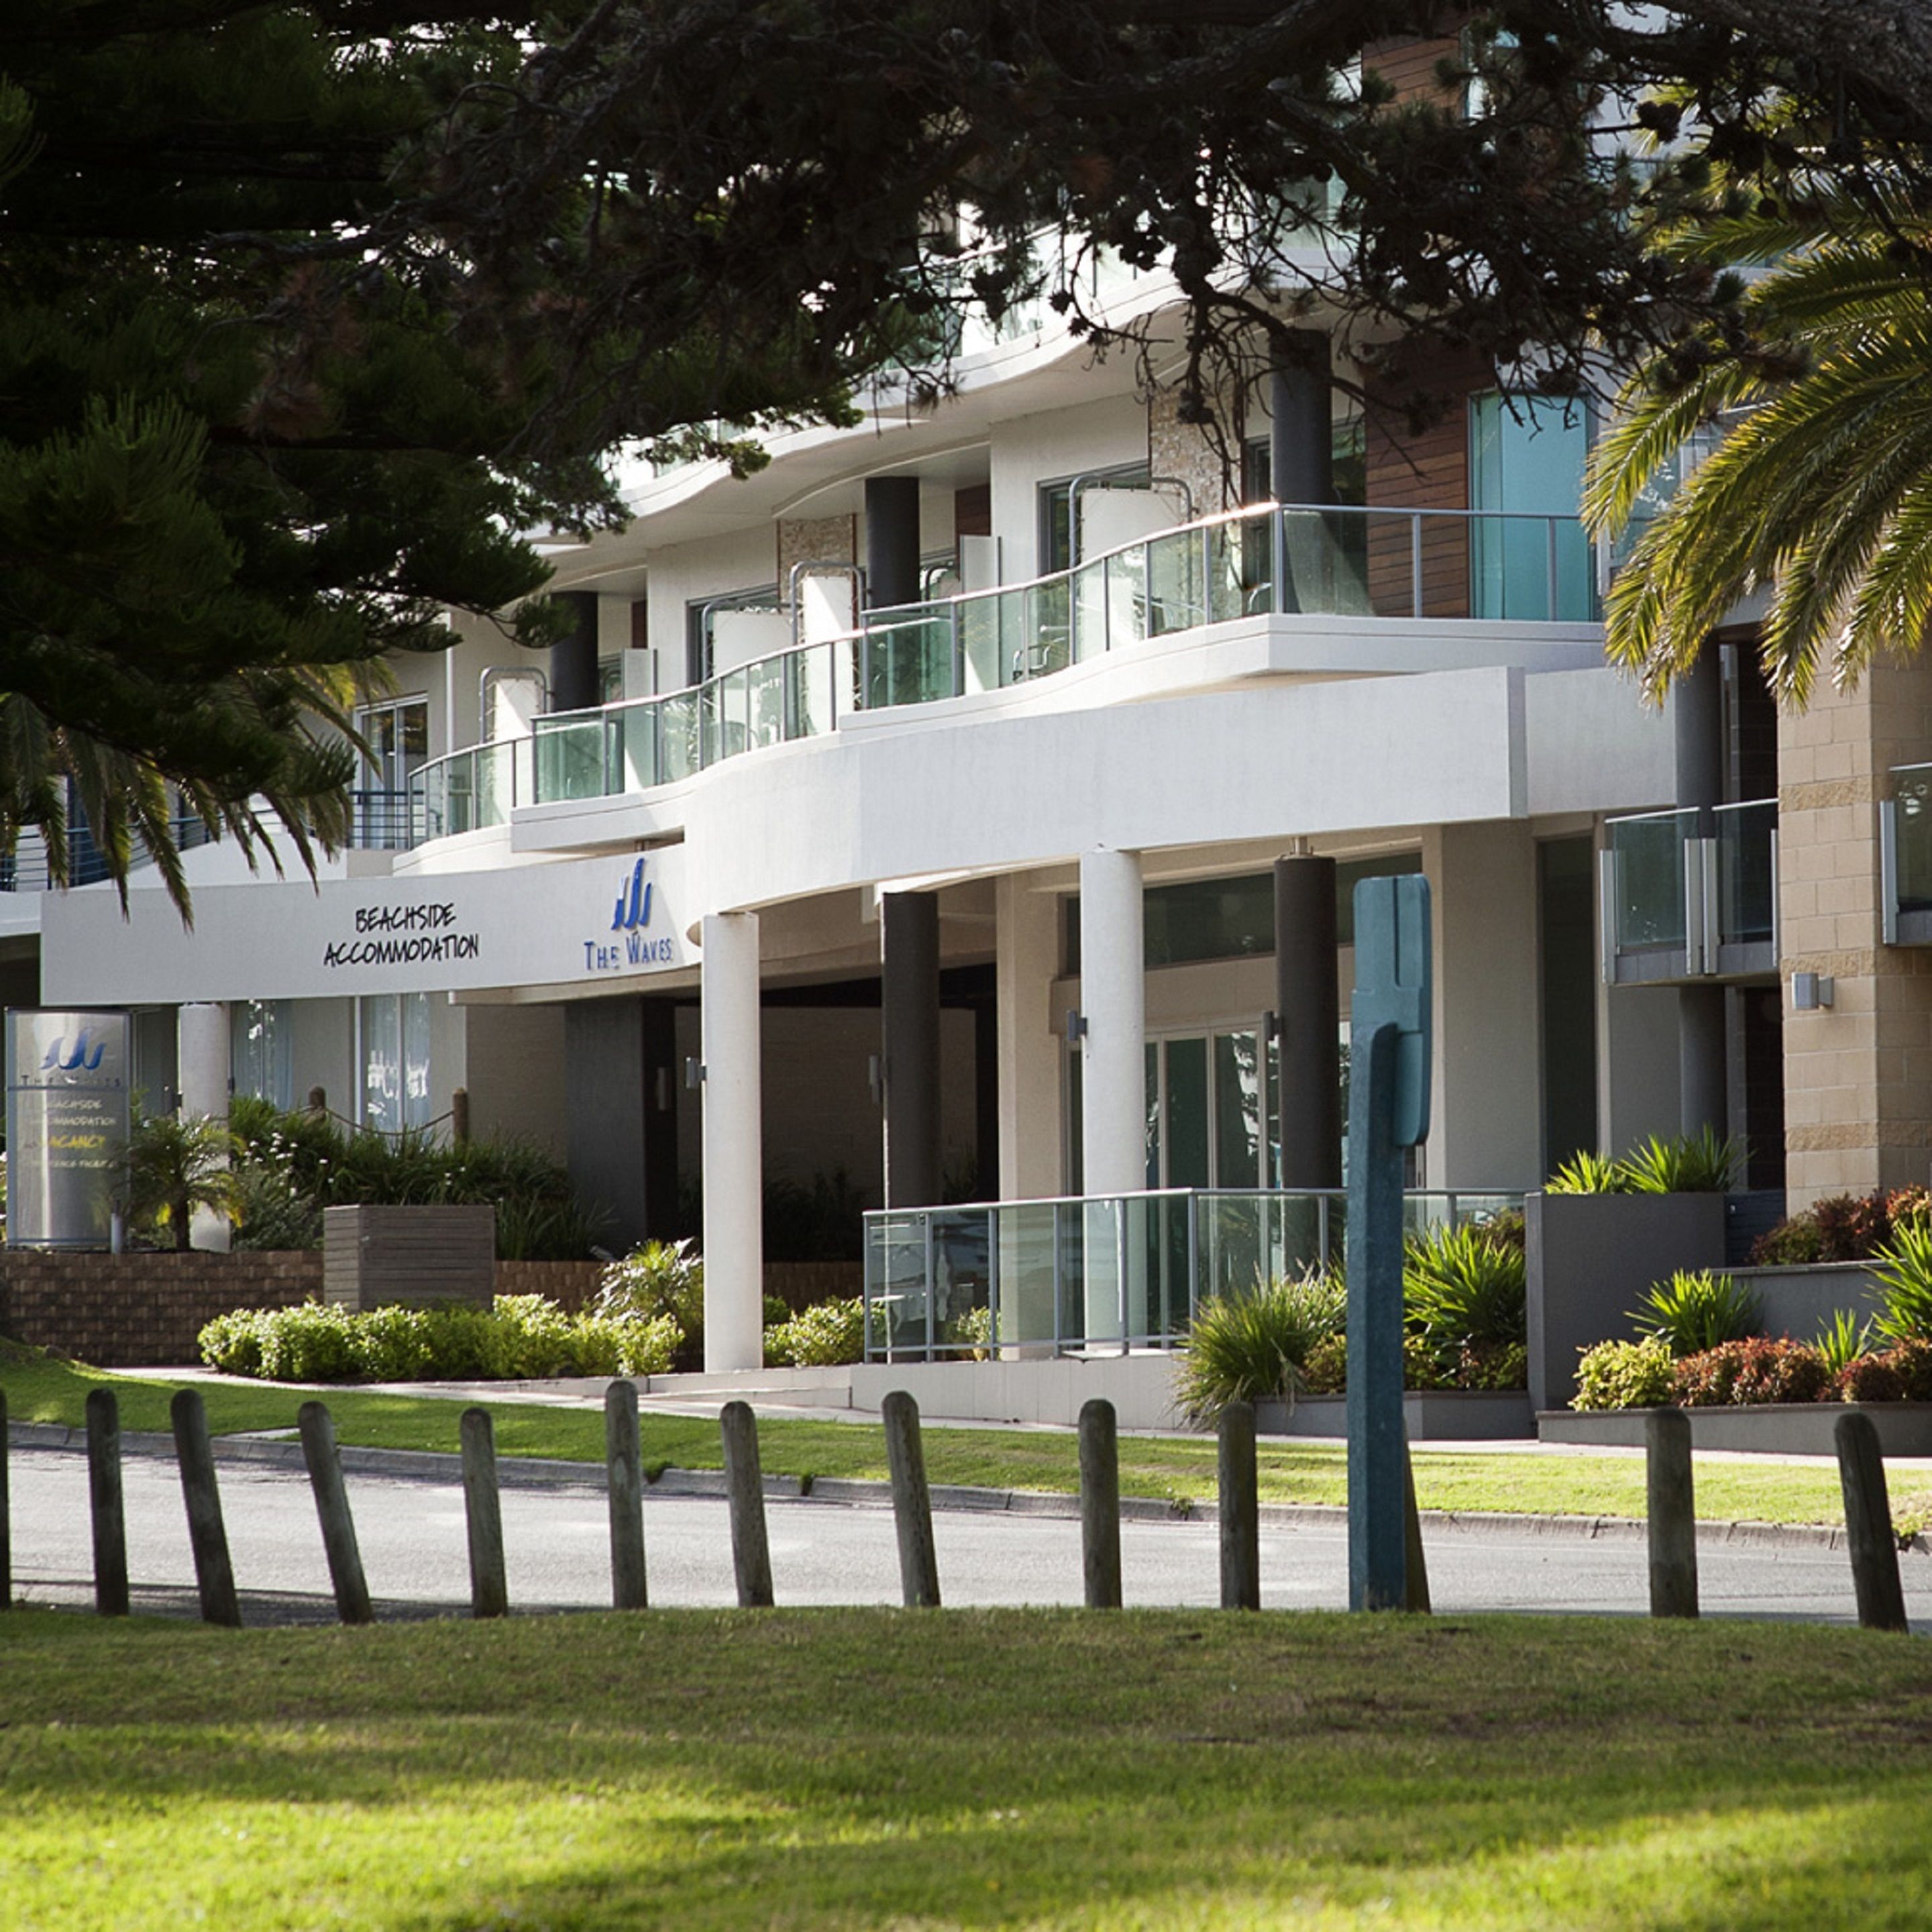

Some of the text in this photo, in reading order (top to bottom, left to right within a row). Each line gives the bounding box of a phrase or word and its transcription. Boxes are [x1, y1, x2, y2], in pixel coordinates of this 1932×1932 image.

[356, 902, 457, 933] BEACHSIDE
[323, 932, 480, 969] ACCOMMODATION
[583, 932, 673, 971] THE WAVES
[41, 1134, 106, 1148] ACANCY
